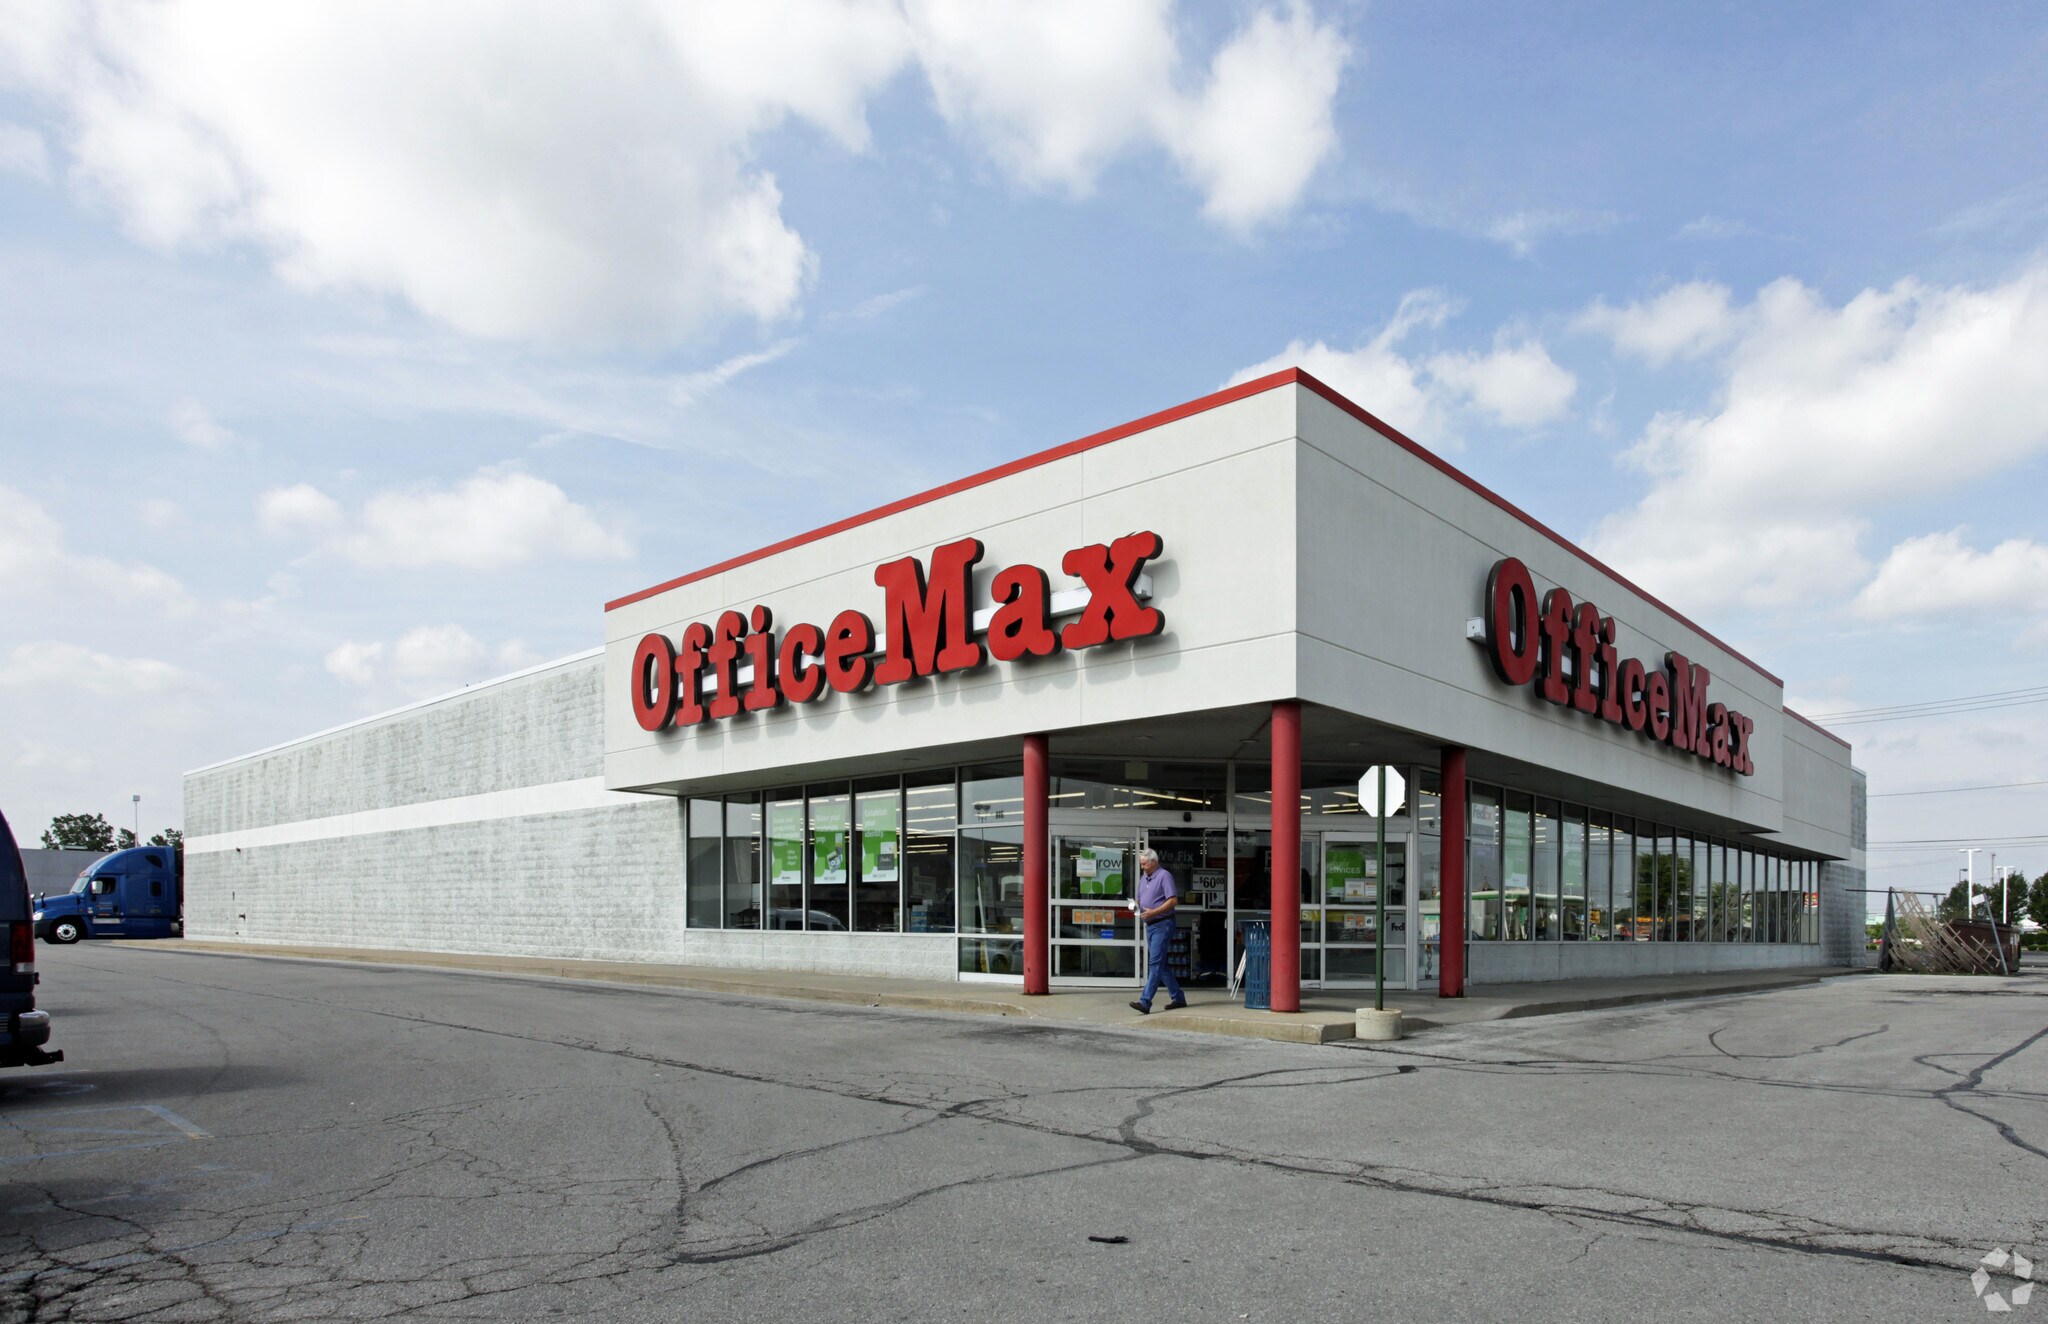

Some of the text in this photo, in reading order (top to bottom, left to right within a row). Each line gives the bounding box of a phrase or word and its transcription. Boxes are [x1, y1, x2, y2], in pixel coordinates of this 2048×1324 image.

[631, 530, 1165, 733] OfficeMax
[1485, 556, 1754, 777] OfficeMax
[864, 807, 888, 817] Establish
[1473, 804, 1492, 821] FedEx
[864, 820, 876, 829] your
[1177, 849, 1194, 862] Fix
